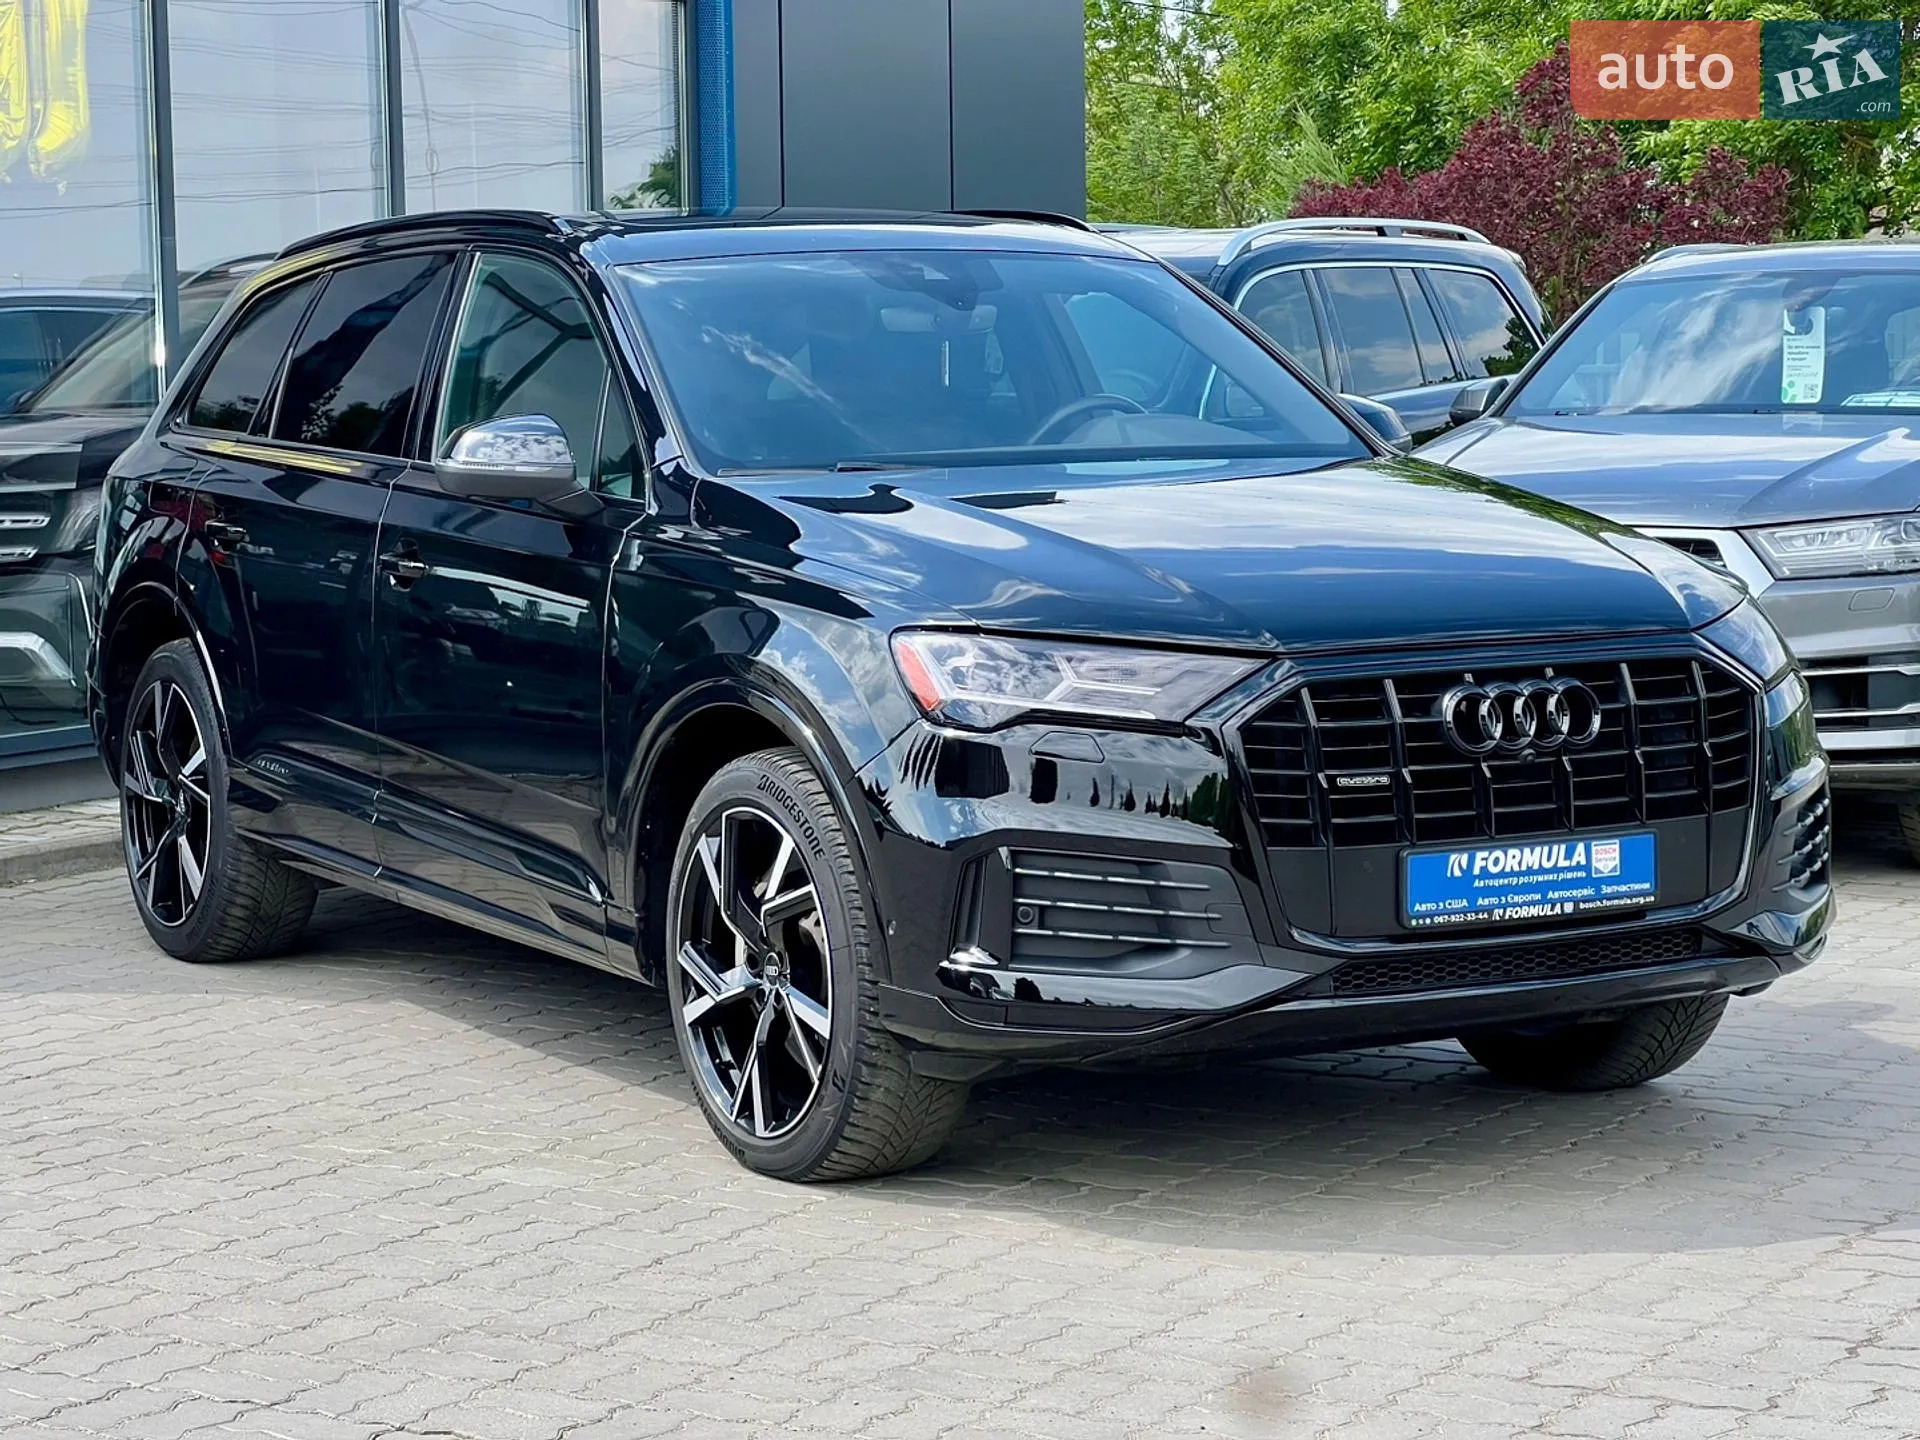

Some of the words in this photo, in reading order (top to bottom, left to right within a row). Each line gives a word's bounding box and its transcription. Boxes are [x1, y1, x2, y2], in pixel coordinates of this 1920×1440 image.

[757, 774, 826, 861] BRIDGESTONE
[1473, 842, 1587, 875] FORMULA
[1594, 847, 1617, 856] BOSCH
[1473, 876, 1518, 888] Автоцентр
[1558, 869, 1586, 881] рішень
[1547, 885, 1596, 899] Автосервіс
[1600, 882, 1651, 894] Запчастини
[1414, 902, 1437, 912] Авто
[1438, 902, 1444, 910] з
[1445, 898, 1468, 909] США
[1477, 897, 1499, 906] Авто
[1500, 896, 1506, 904] з
[1507, 893, 1541, 904] Європи
[1505, 902, 1561, 919] FORMULA
